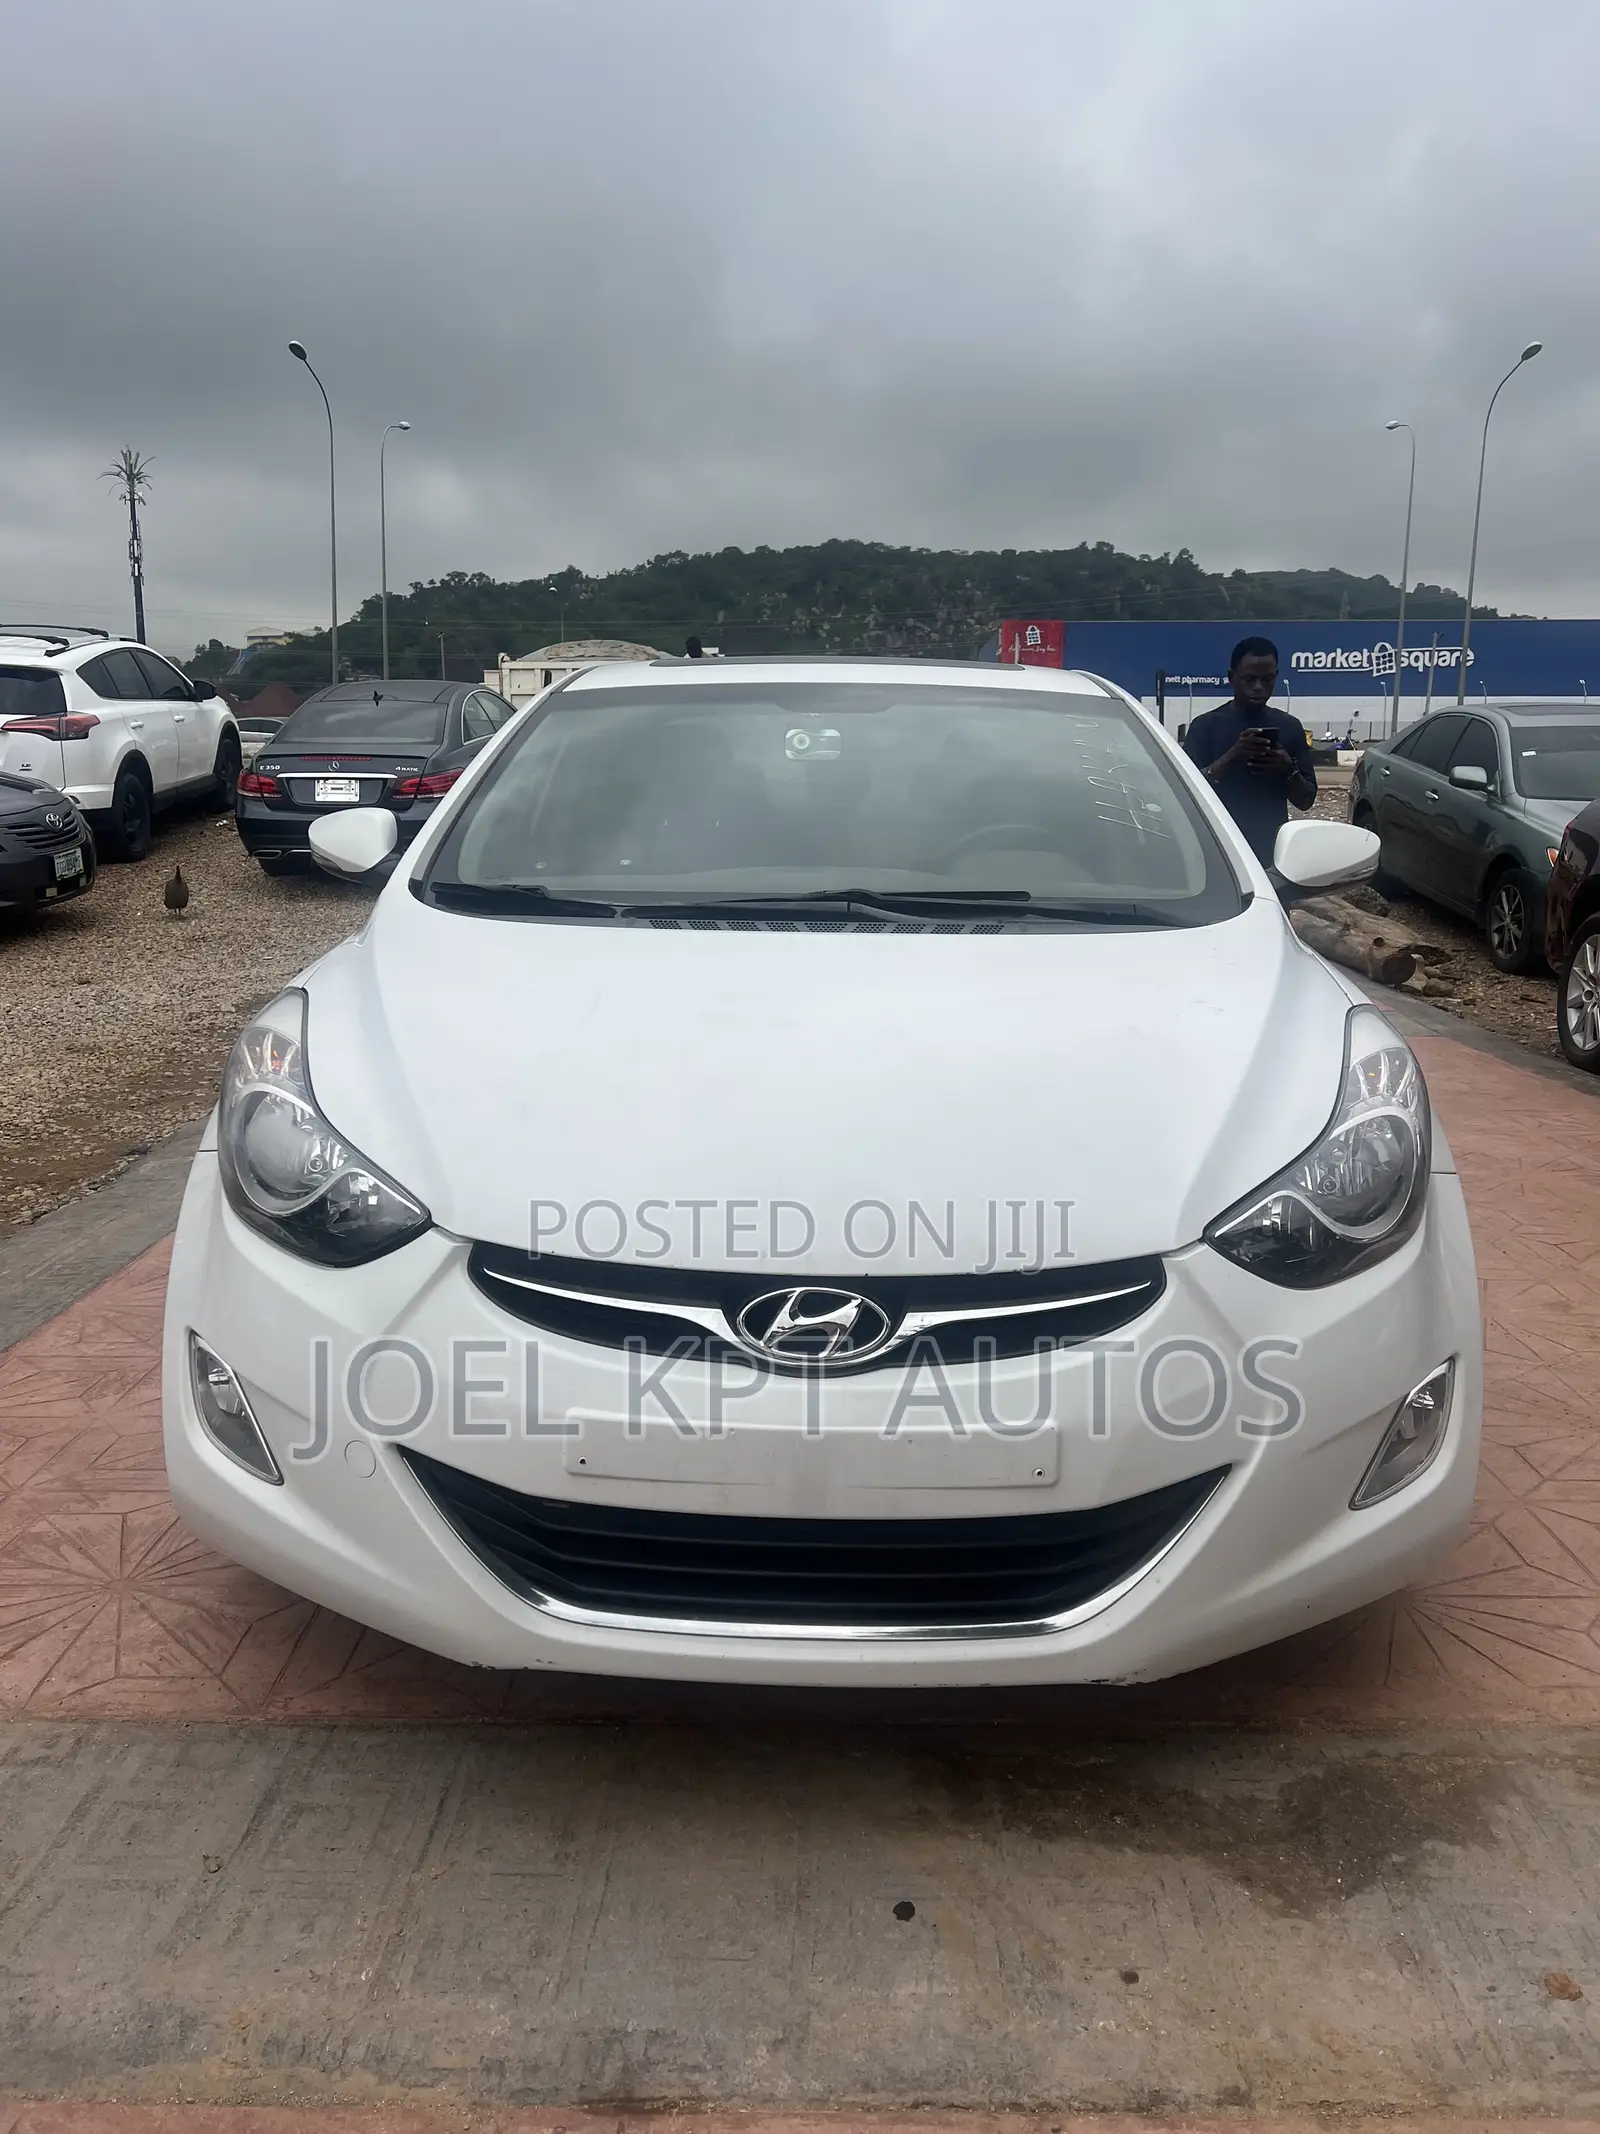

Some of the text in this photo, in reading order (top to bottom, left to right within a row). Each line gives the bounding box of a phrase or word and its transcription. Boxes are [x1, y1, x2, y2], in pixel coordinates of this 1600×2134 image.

[1291, 647, 1475, 672] market square
[1182, 676, 1220, 686] pharmacy
